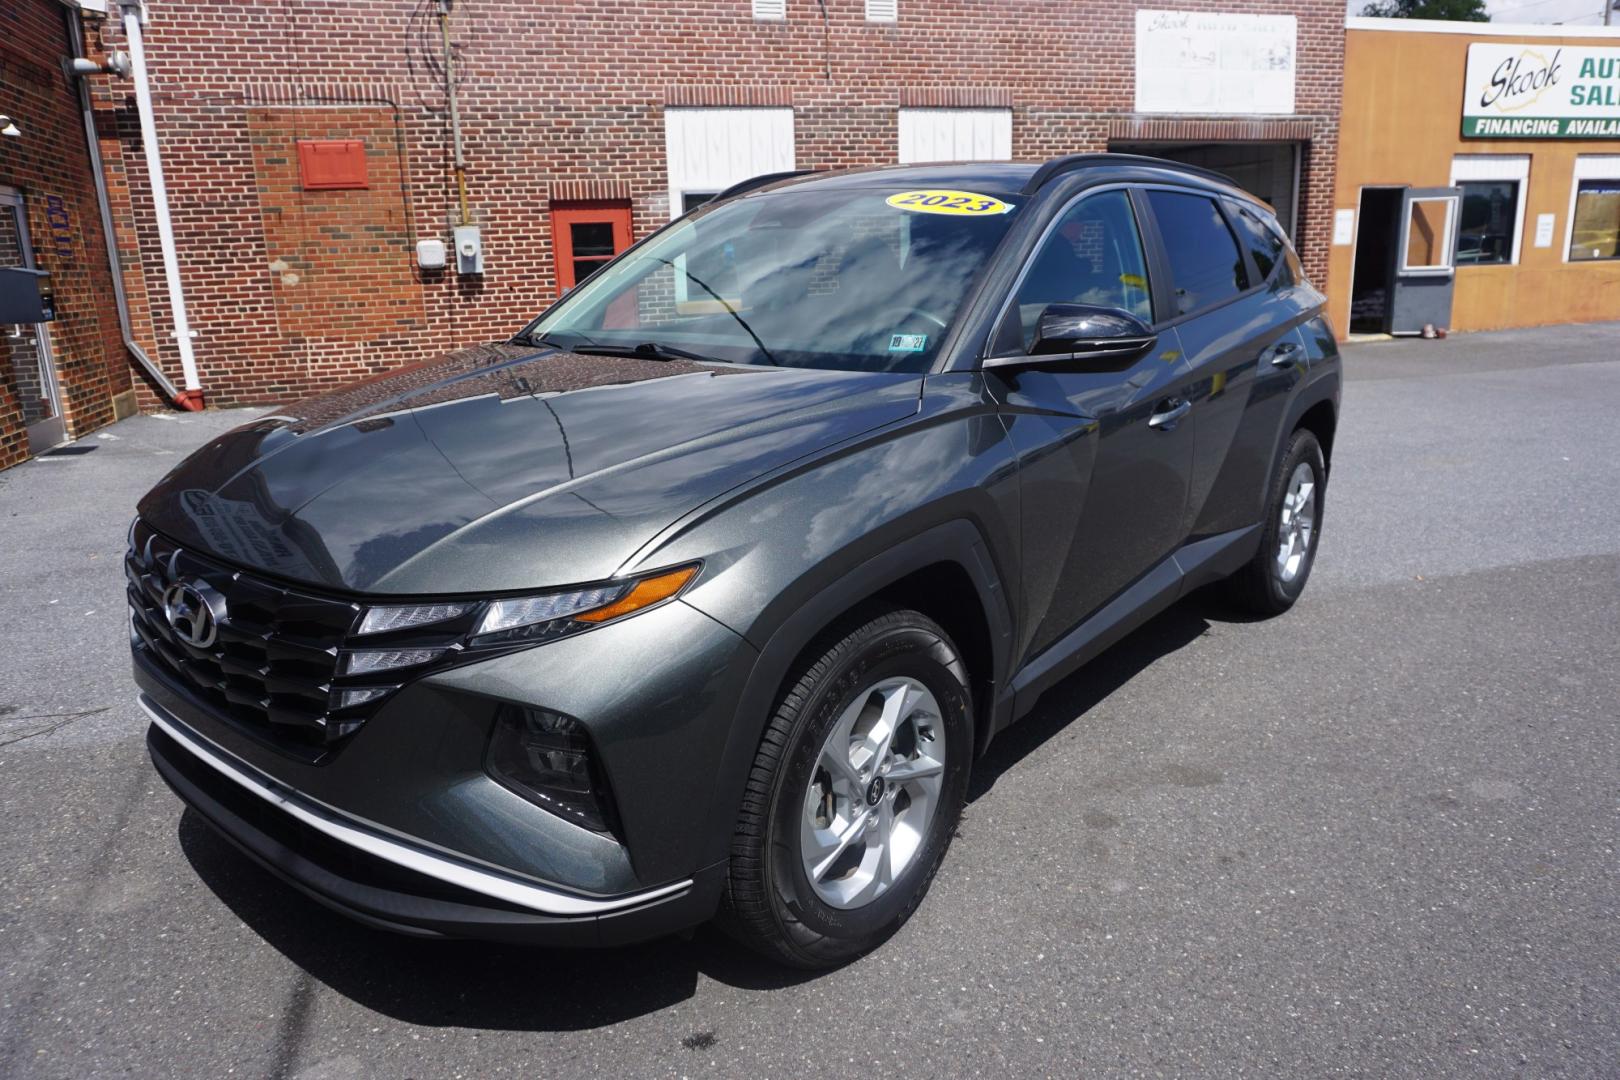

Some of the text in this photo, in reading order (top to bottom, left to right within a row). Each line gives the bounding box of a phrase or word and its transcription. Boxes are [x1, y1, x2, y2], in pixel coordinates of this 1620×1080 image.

[1480, 48, 1562, 107] Skook
[1570, 85, 1620, 106] SAL
[1475, 119, 1560, 135] FINANCING
[898, 193, 996, 212] 2023
